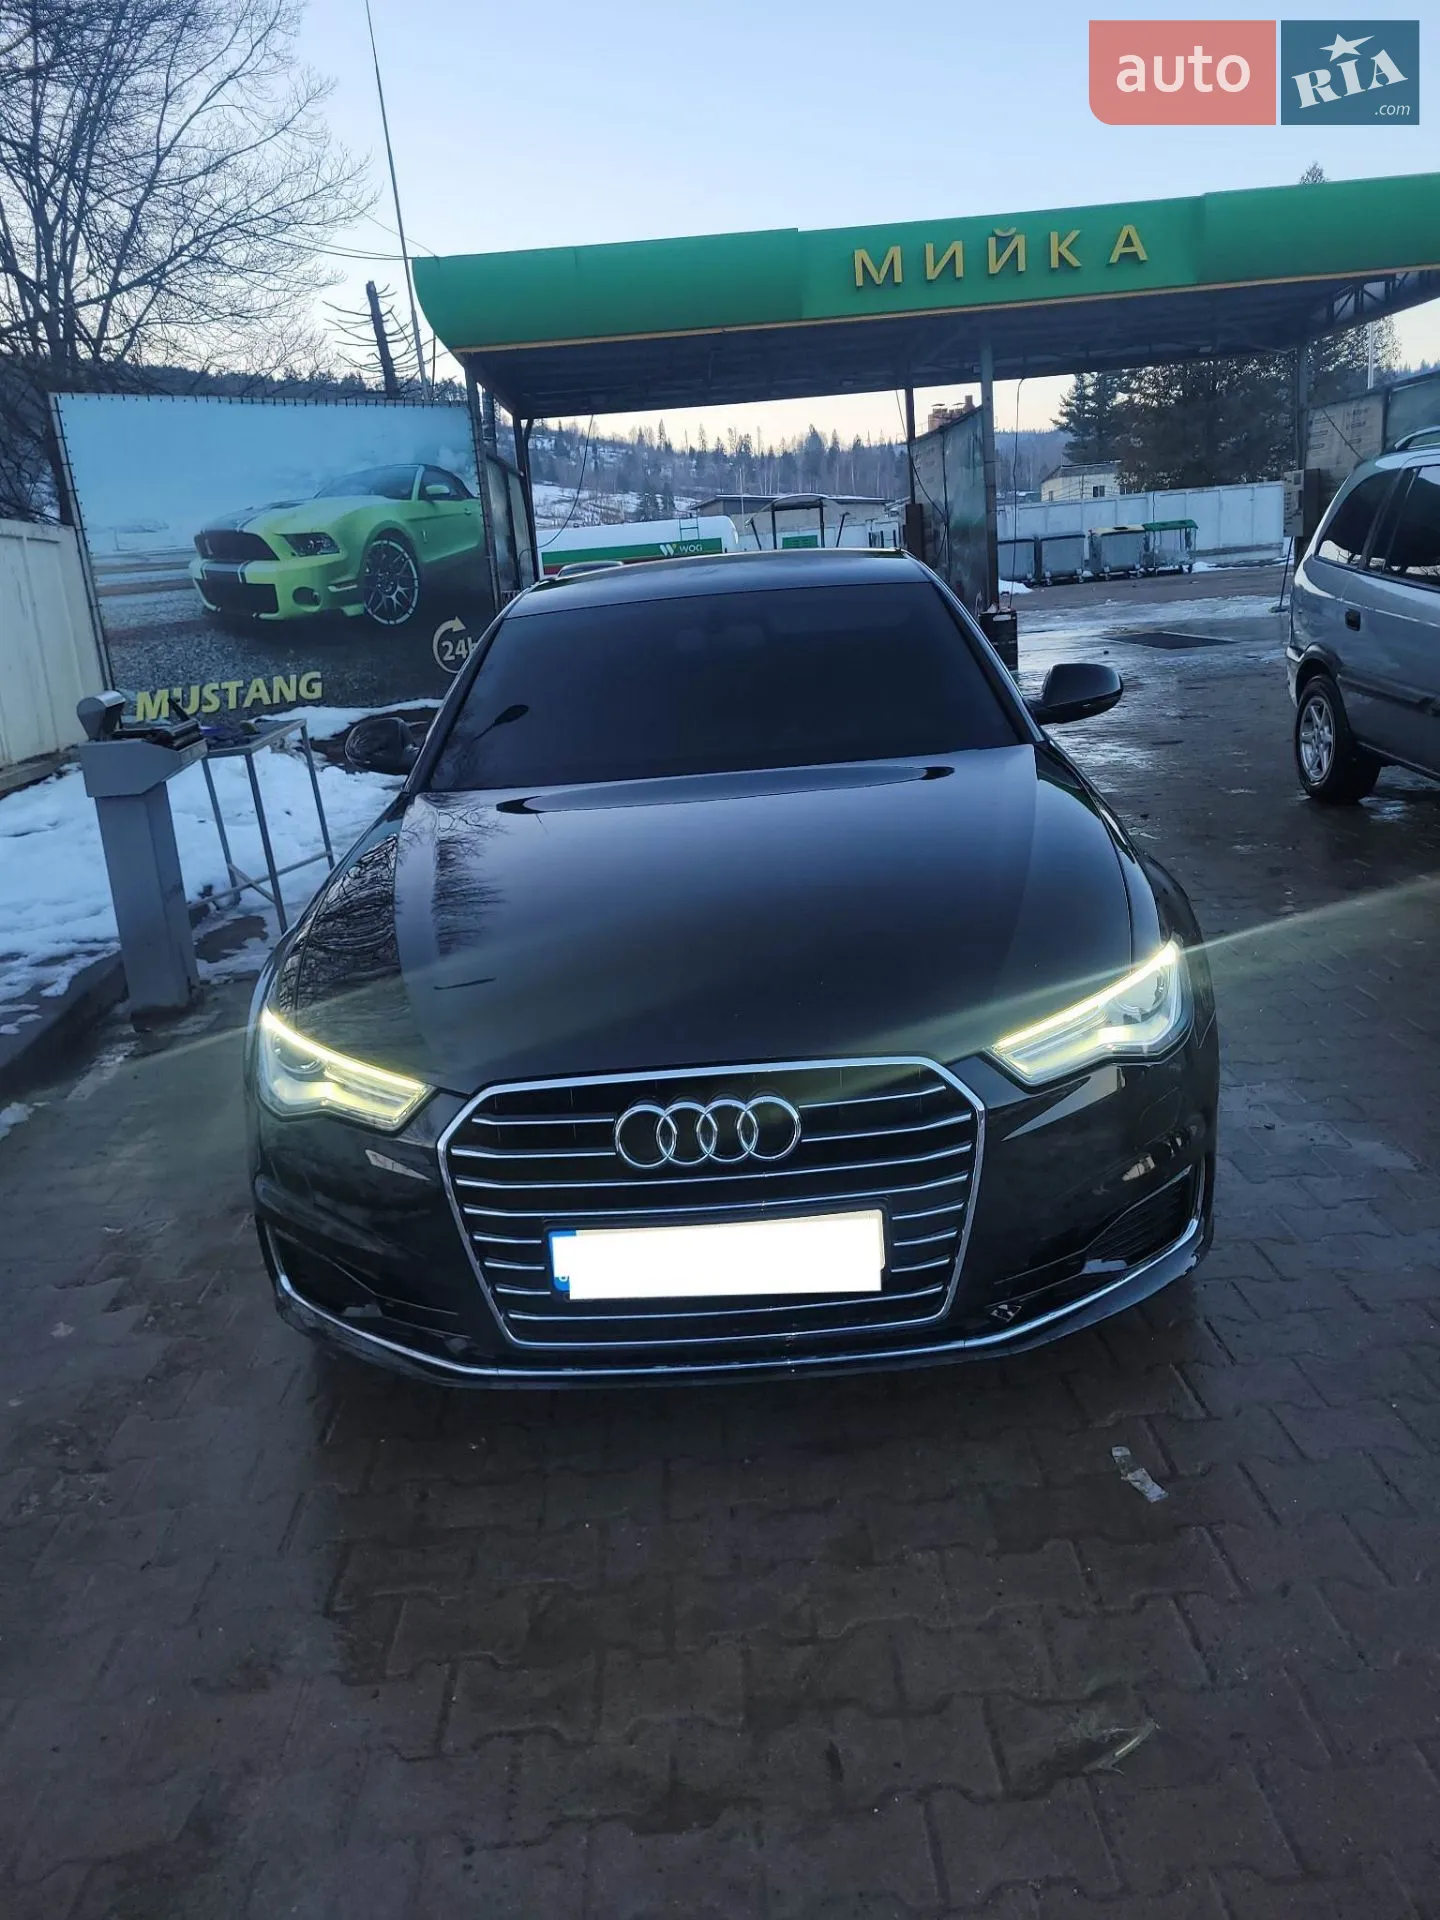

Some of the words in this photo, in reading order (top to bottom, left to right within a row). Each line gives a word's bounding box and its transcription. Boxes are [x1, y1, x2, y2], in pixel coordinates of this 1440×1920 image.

[853, 224, 1149, 288] МИЙКА
[679, 543, 703, 553] WOG
[135, 671, 323, 721] MUSTANG
